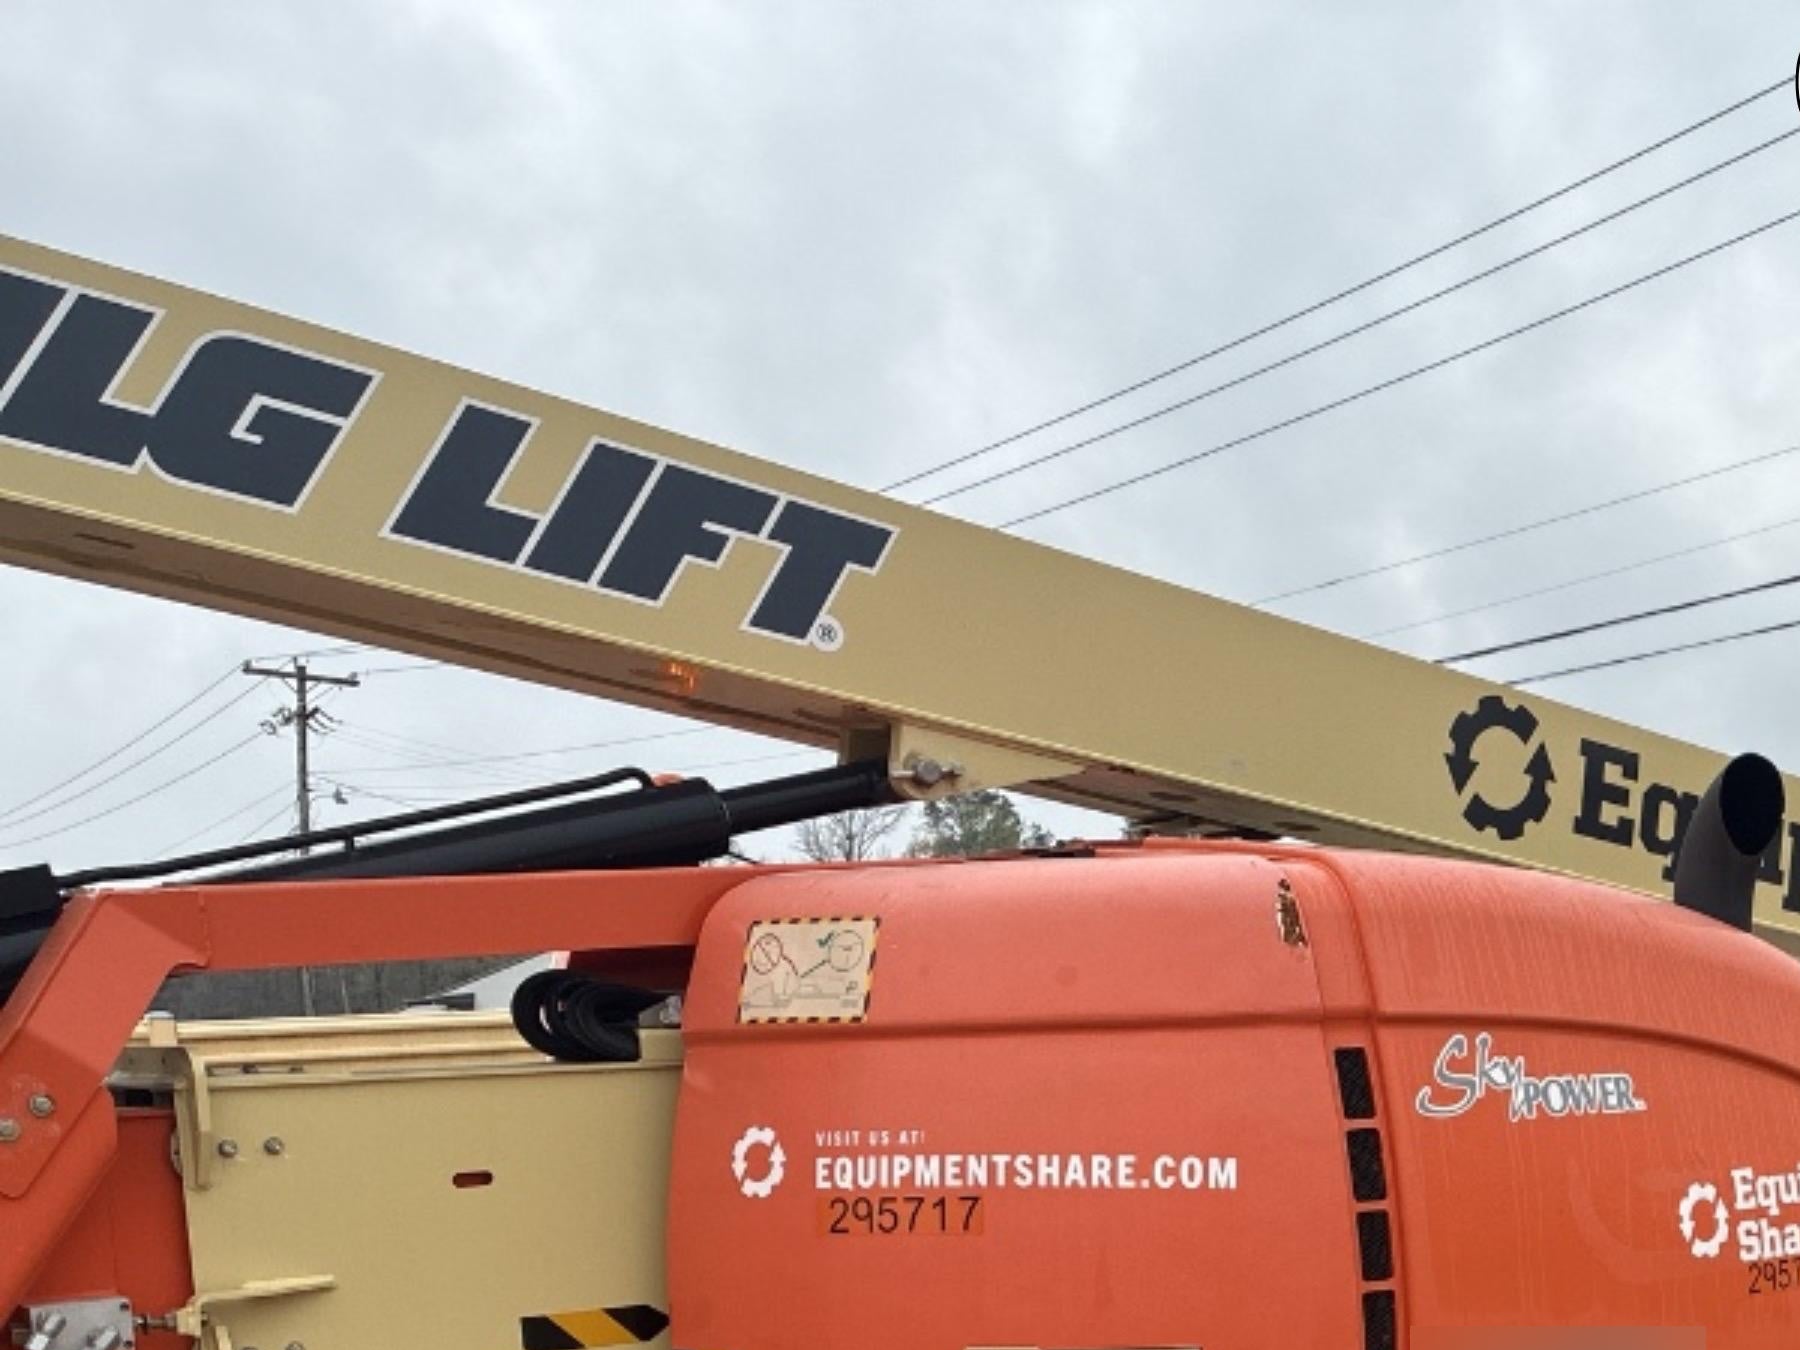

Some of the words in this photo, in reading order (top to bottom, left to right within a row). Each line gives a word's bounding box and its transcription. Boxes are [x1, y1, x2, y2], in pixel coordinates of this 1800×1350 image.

[379, 394, 901, 647] LIFT
[815, 1129, 861, 1146] VISIT
[869, 1129, 890, 1146] US
[815, 1153, 1238, 1191] EQUIPMENTSHARE.COM
[829, 1196, 982, 1234] 295717
